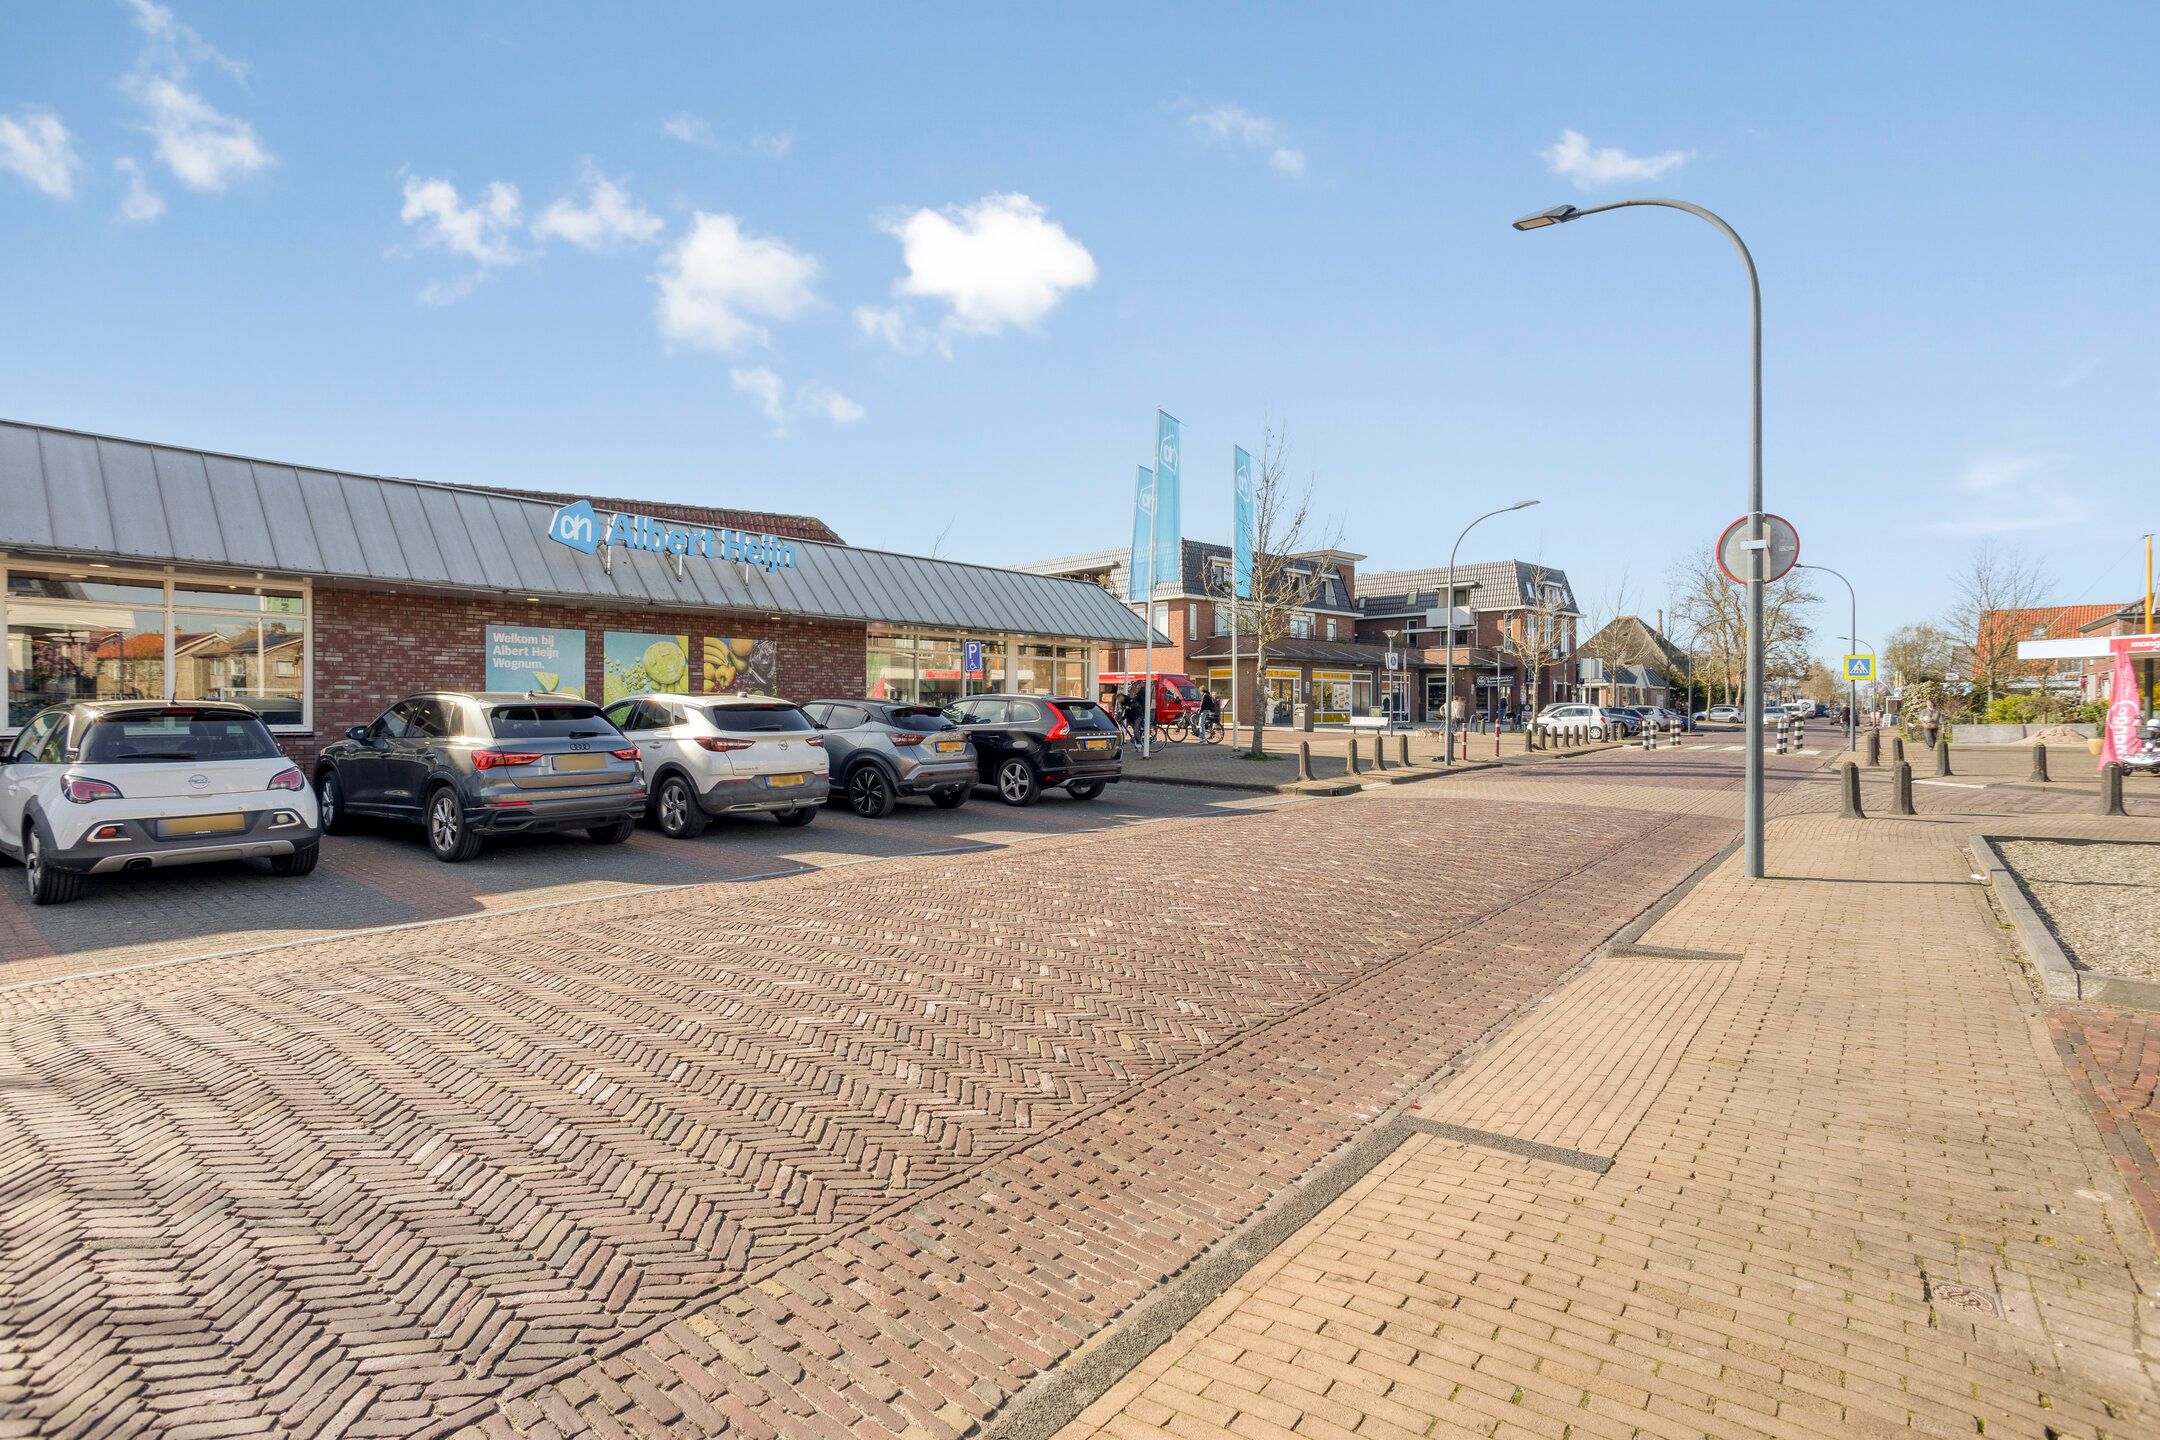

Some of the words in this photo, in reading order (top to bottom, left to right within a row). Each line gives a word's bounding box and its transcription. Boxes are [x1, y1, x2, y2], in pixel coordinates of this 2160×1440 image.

[607, 513, 715, 559] Albert
[722, 528, 796, 573] Heijn
[492, 633, 538, 644] Welkom
[541, 635, 555, 647] bij
[492, 645, 529, 657] Albert
[532, 647, 559, 659] Heijn
[968, 644, 977, 659] P
[492, 658, 545, 670] Wognum.
